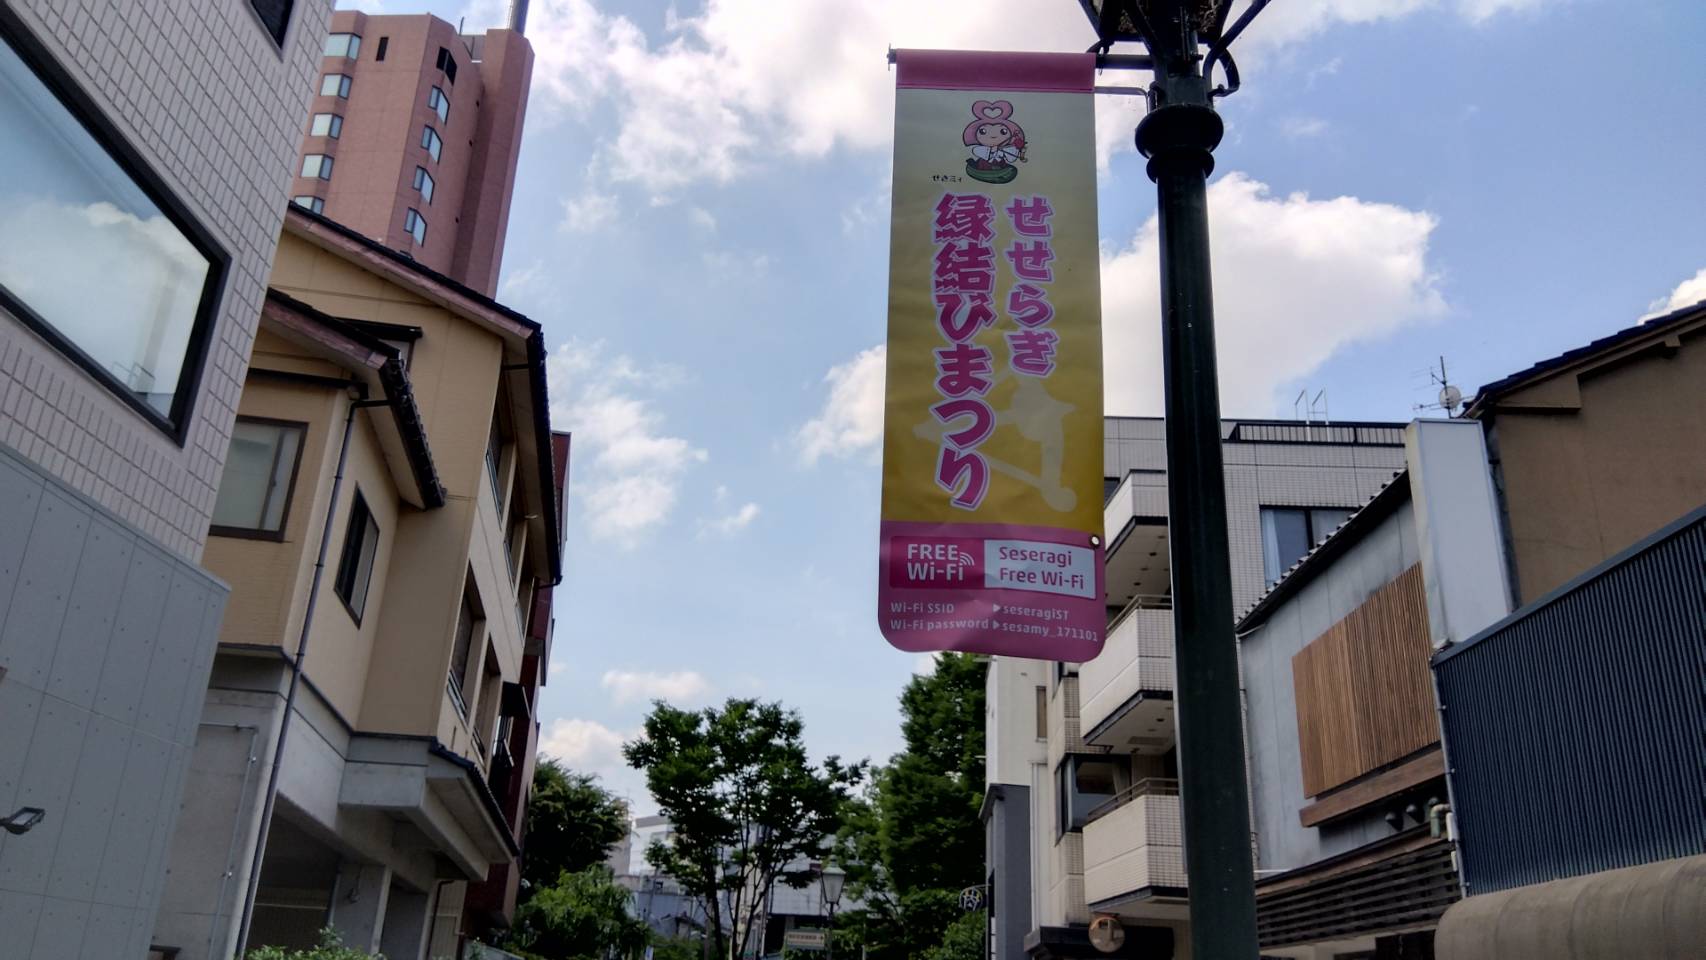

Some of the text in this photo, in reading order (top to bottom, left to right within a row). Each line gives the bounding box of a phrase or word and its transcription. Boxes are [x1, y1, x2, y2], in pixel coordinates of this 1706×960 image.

[1006, 196, 1057, 376] せせらぎ
[931, 192, 996, 511] 縁結びまつり
[908, 544, 958, 560] FREE
[999, 546, 1072, 567] Seseragi
[907, 562, 964, 581] Wi-Fi
[1000, 568, 1084, 589] Free Wi-Fi
[890, 602, 1069, 621] Wi-Fi SSID seseragiST
[890, 618, 1098, 642] Wi-Fi password sesamy_171101
